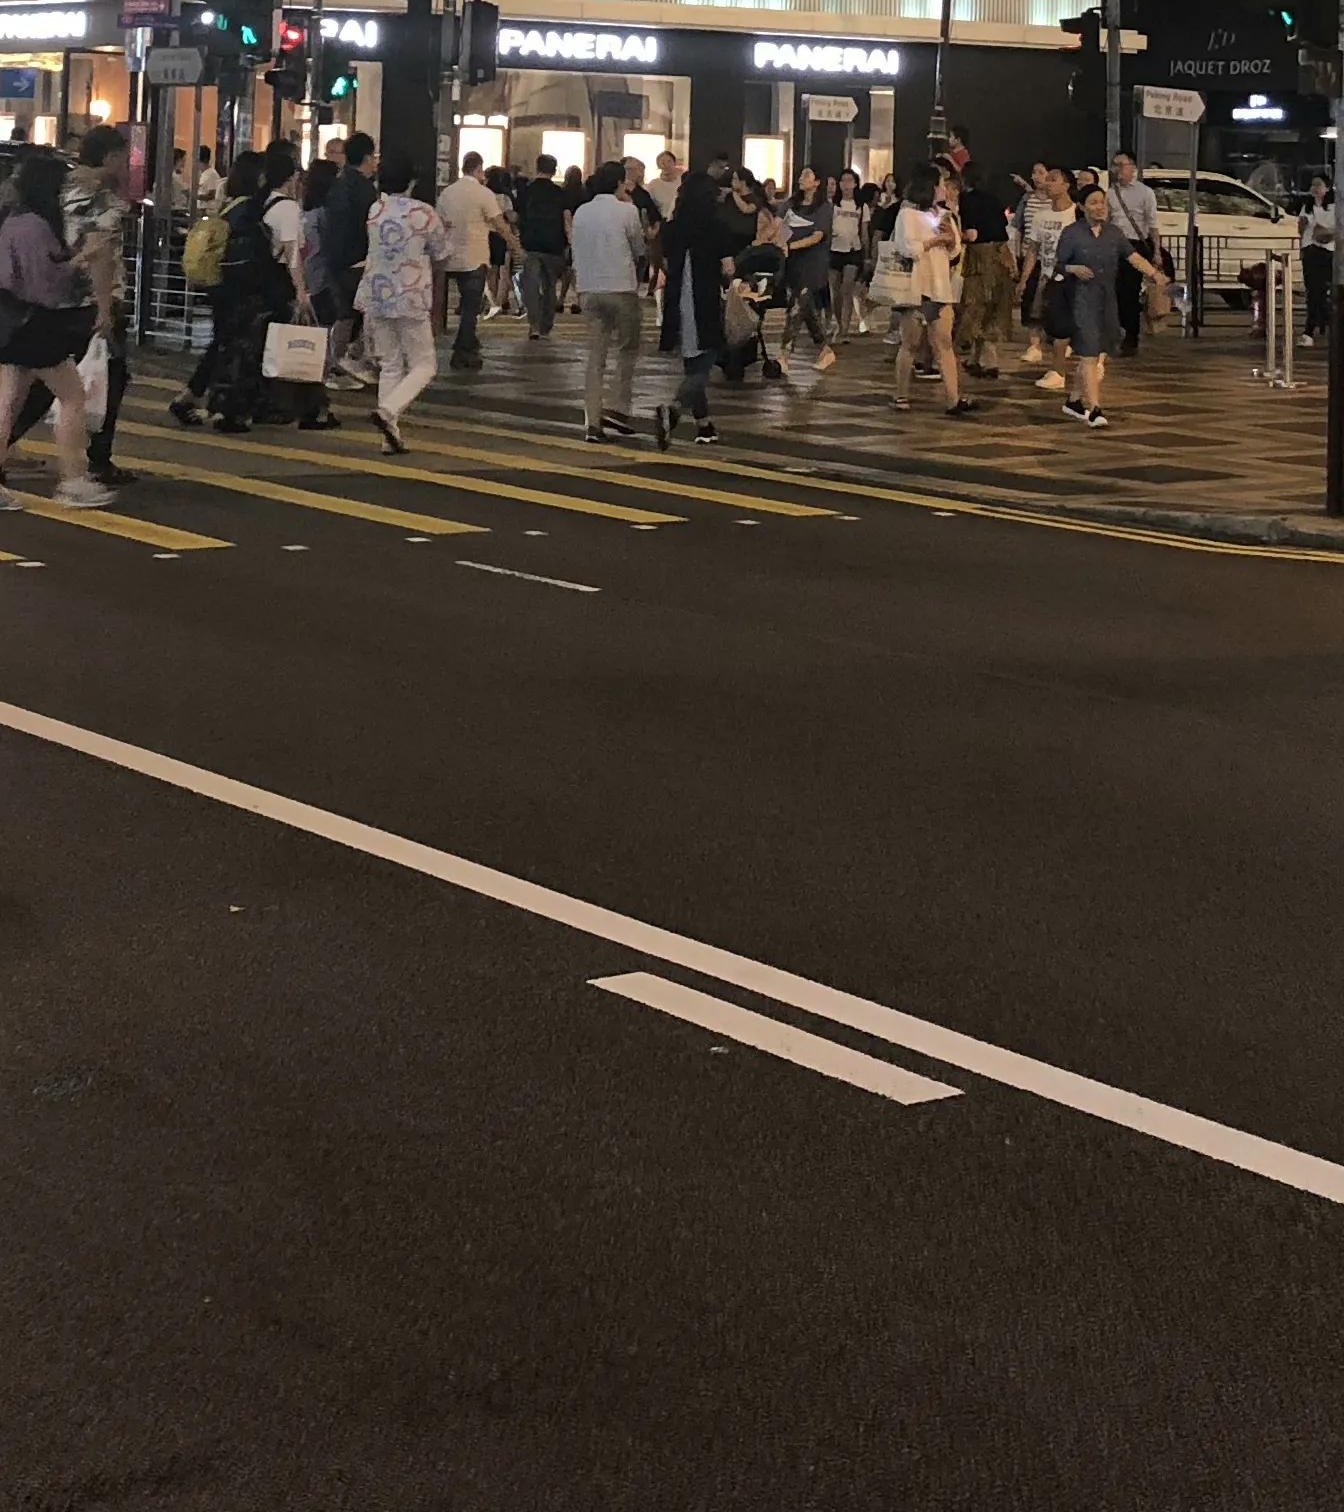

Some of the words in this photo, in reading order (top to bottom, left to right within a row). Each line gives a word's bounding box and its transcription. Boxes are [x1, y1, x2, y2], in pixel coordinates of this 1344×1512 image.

[499, 28, 657, 63] PANERAI
[754, 41, 900, 76] PANERAI
[1169, 59, 1225, 78] JAQUET
[1229, 59, 1272, 75] DROZ
